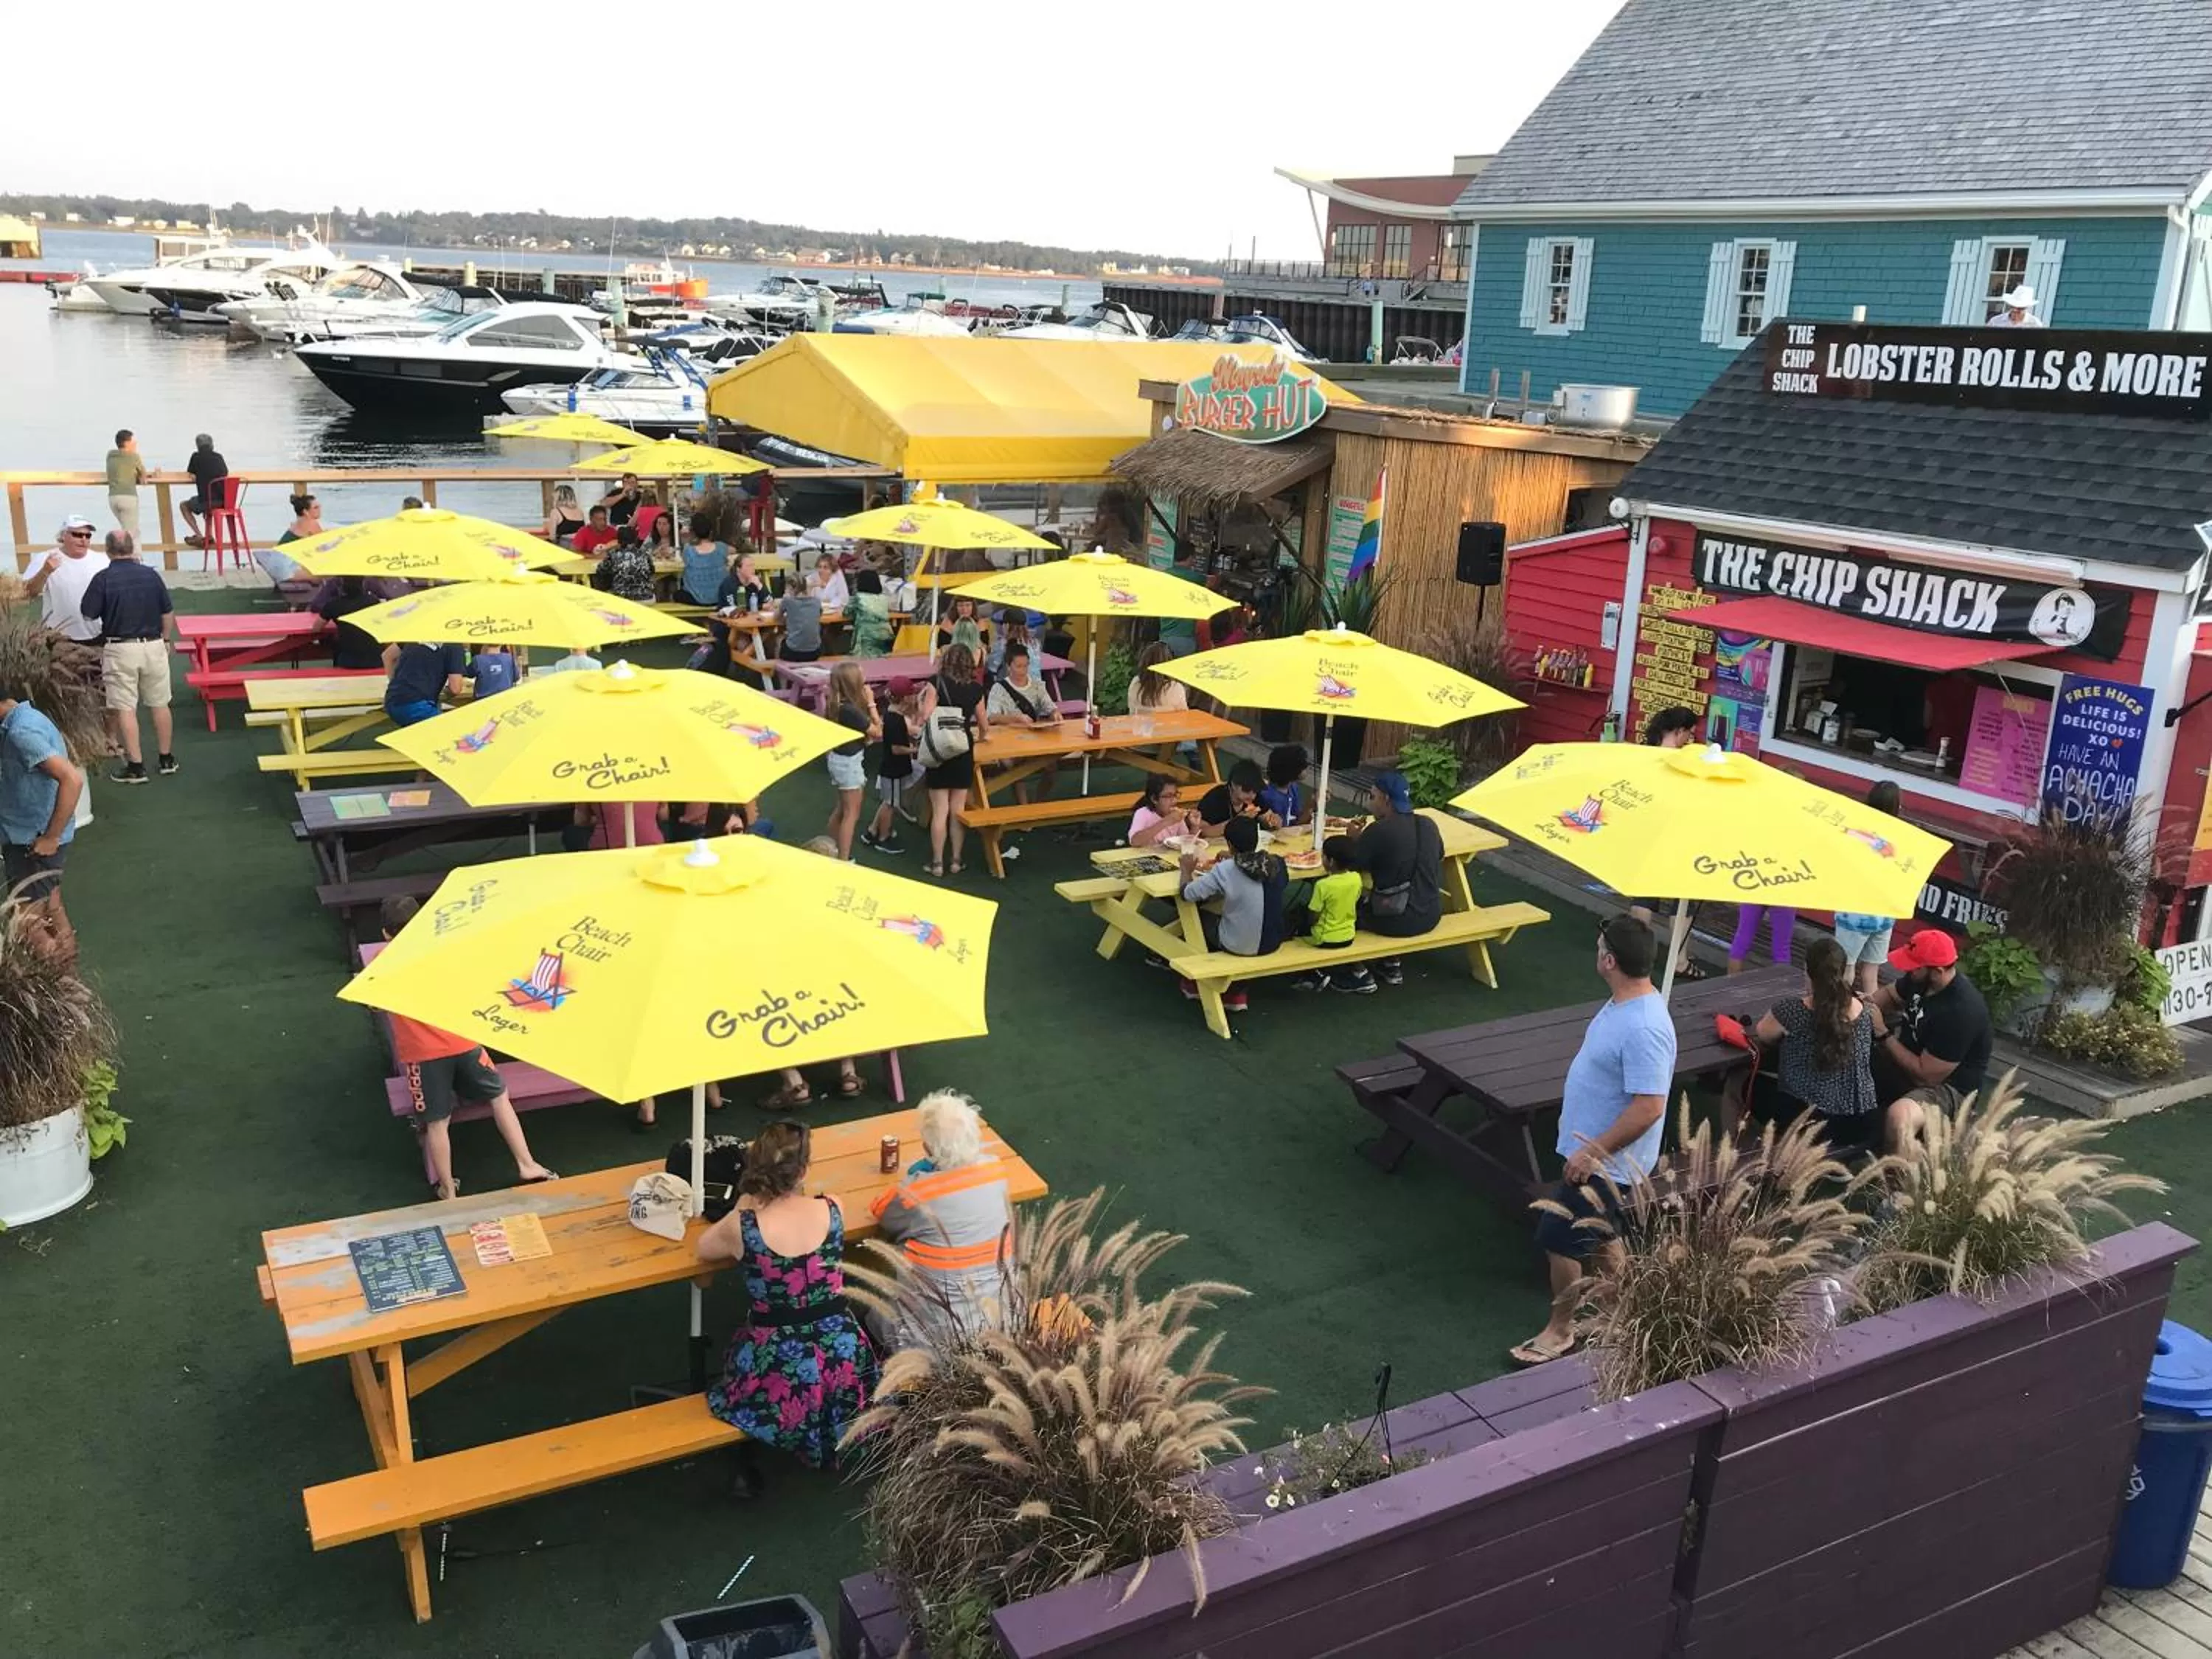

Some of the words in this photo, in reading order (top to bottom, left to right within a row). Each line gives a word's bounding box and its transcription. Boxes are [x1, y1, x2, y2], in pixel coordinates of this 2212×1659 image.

[1788, 325, 1815, 345] THE
[1781, 348, 1815, 369] CHIP
[1826, 343, 1956, 384] LOBSTER
[1958, 347, 2065, 390] ROLLS
[2067, 351, 2095, 391] &
[2099, 352, 2208, 397] MORE
[1772, 372, 1818, 394] SHACK
[1182, 383, 1257, 431] BURGER
[1262, 378, 1318, 432] HUT
[1701, 539, 1767, 591] THE
[1768, 551, 1860, 608] CHIP
[1862, 566, 2008, 633] SHACK
[2065, 686, 2101, 704] FREE
[2104, 686, 2144, 716] HUGS
[2080, 703, 2110, 718] LIFE
[2114, 709, 2127, 722] IS
[2062, 714, 2142, 740] DELICIOUS!
[2087, 734, 2108, 746] XO
[552, 753, 619, 779] Grab
[2058, 743, 2094, 765] HAVE
[2100, 751, 2120, 770] AN
[586, 757, 672, 790] Chair!
[1599, 788, 1638, 810] Chair
[1611, 779, 1654, 803] Beach
[1534, 822, 1571, 844] Lager
[1694, 850, 1759, 874] Grab
[1733, 859, 1816, 890] Chair!
[570, 915, 633, 948] Beach
[556, 933, 612, 963] Chair
[2164, 944, 2212, 977] OPEN
[472, 1004, 530, 1035] Lager
[706, 989, 790, 1039] Grab
[795, 990, 813, 1001] a
[762, 982, 866, 1048] Chair!
